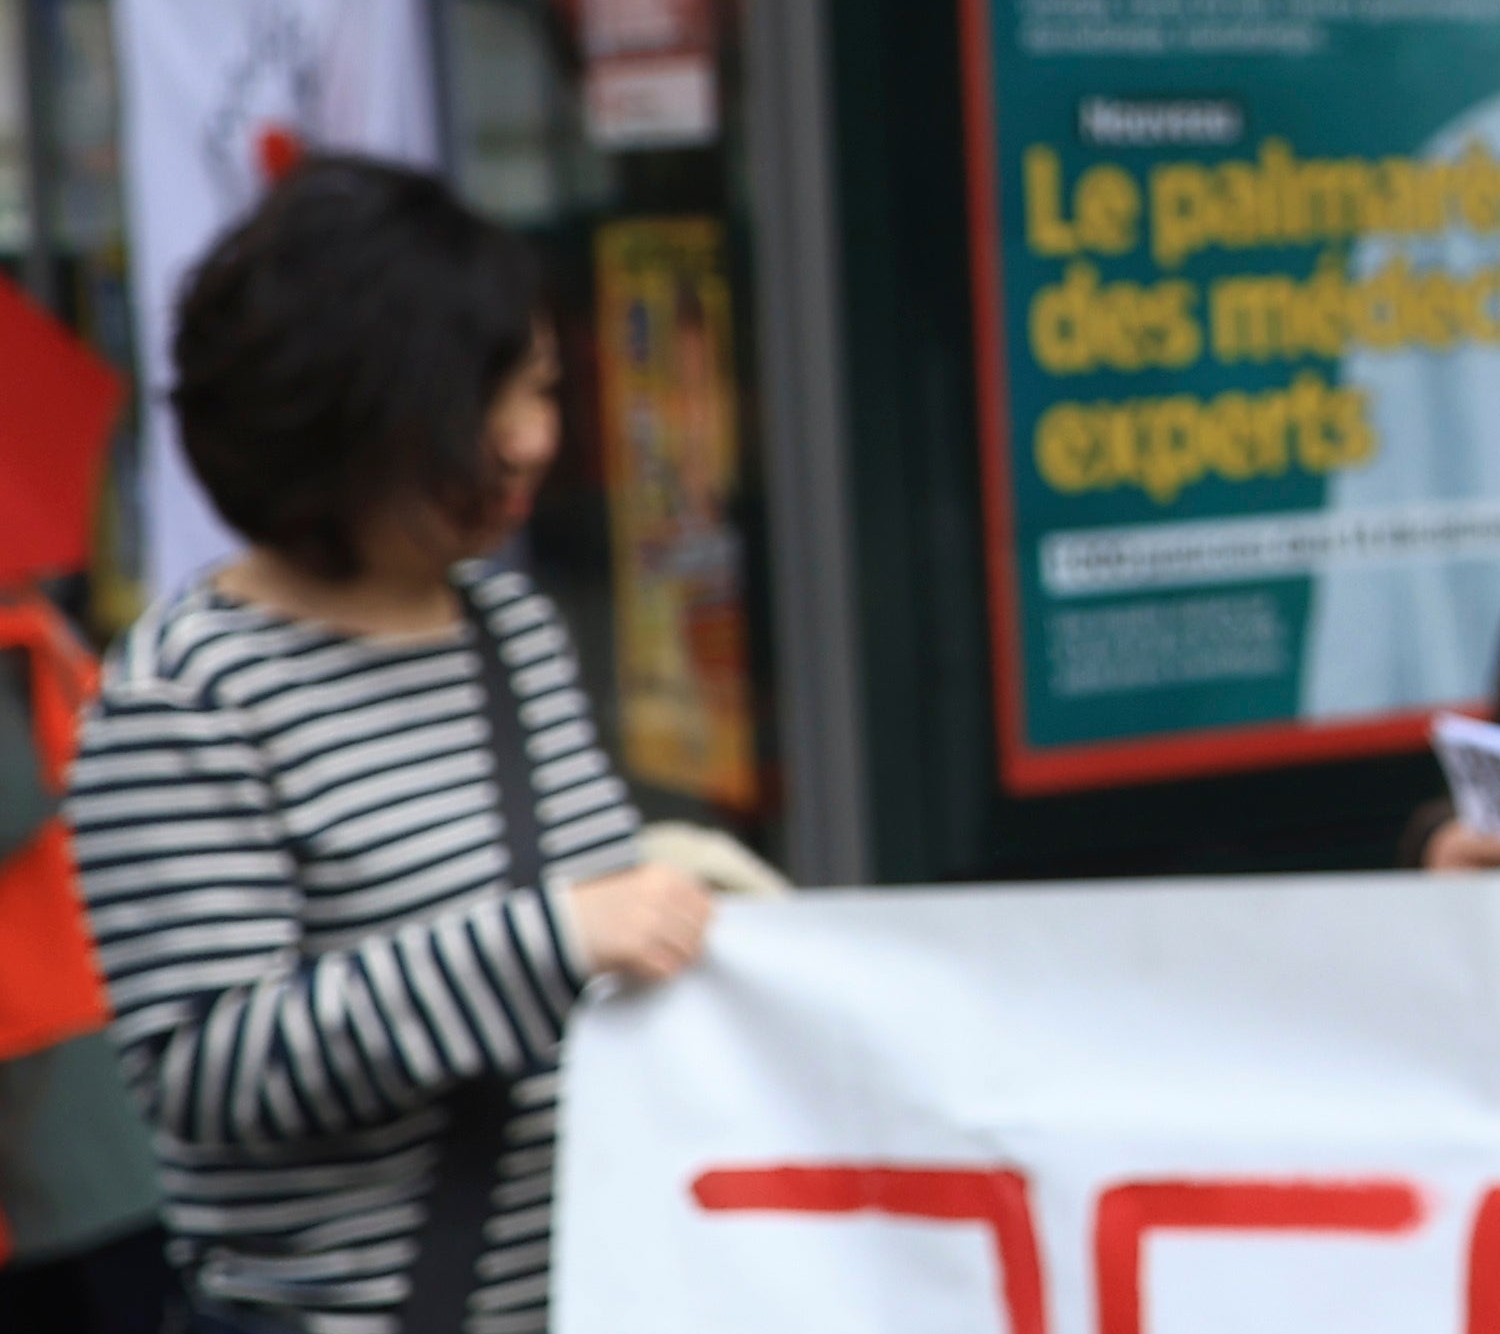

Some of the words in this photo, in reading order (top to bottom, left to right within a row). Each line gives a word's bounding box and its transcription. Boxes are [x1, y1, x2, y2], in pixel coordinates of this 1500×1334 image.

[1025, 145, 1140, 254] Le
[1030, 261, 1196, 371] des
[1035, 371, 1376, 502] experts
